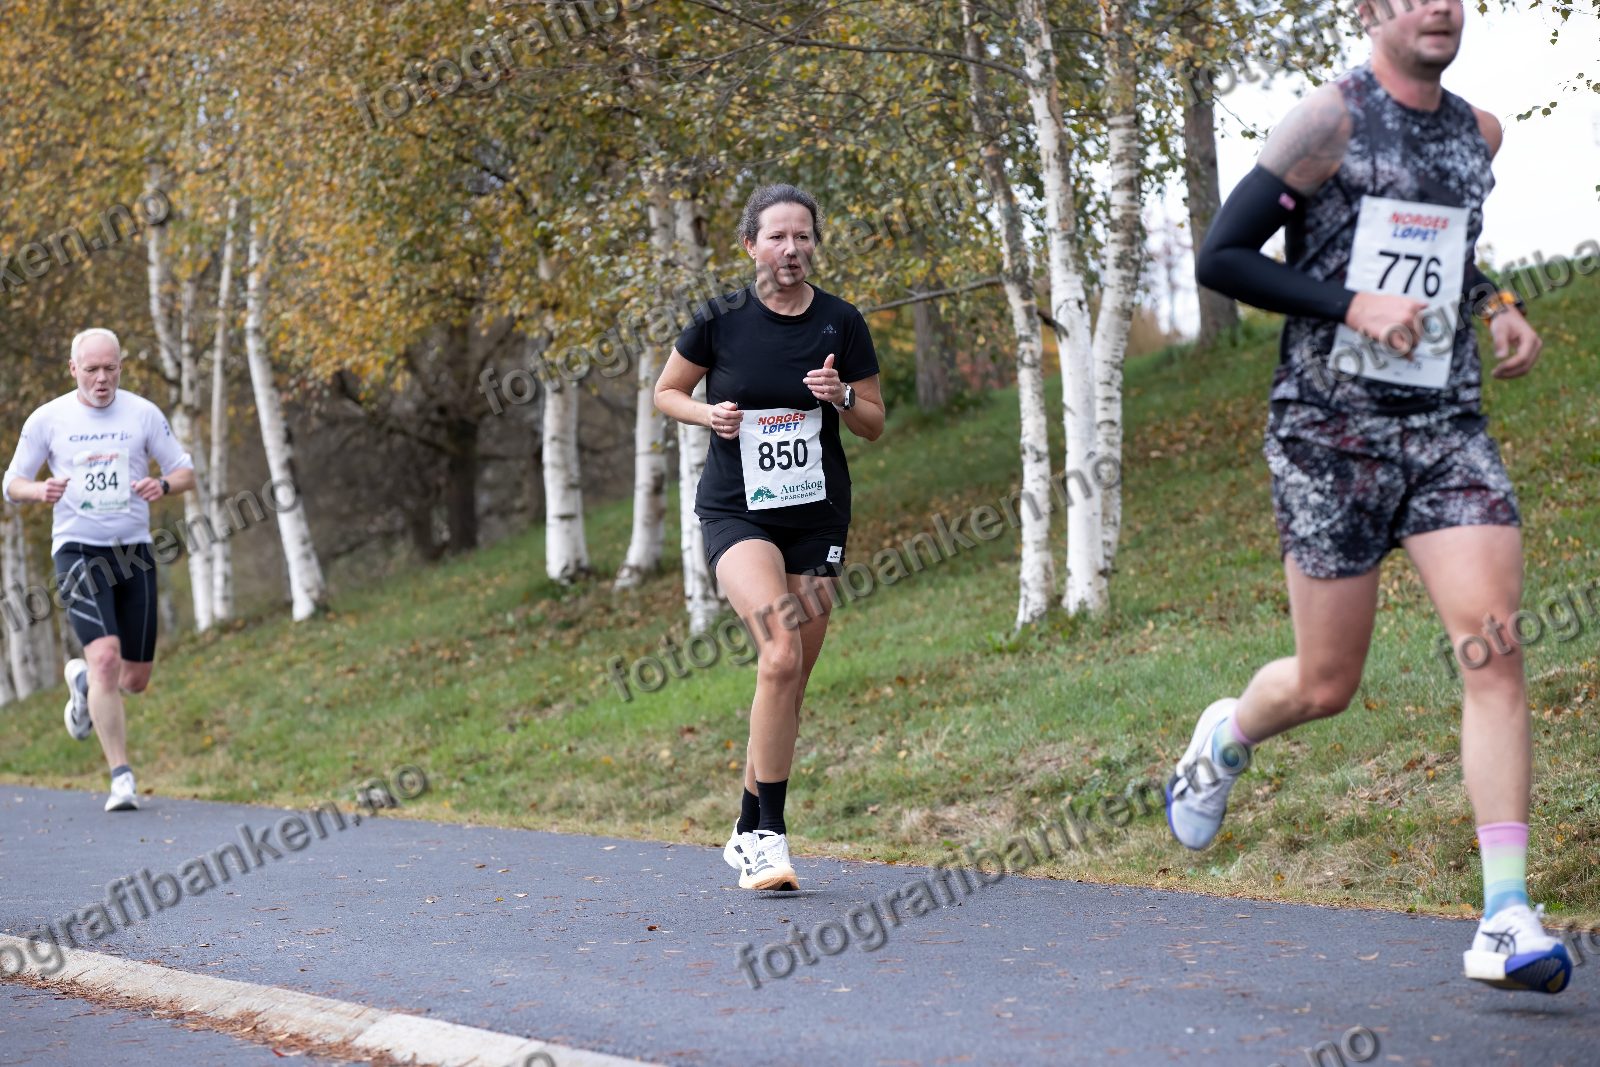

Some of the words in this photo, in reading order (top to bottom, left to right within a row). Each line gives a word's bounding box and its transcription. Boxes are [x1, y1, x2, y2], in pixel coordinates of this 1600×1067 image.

[1377, 251, 1443, 298] 776
[757, 413, 806, 426] NORGES
[762, 422, 800, 435] LØPET
[69, 432, 118, 441] CRAFT
[758, 438, 808, 472] 850
[85, 471, 119, 492] 334
[780, 480, 823, 494] Aurskog
